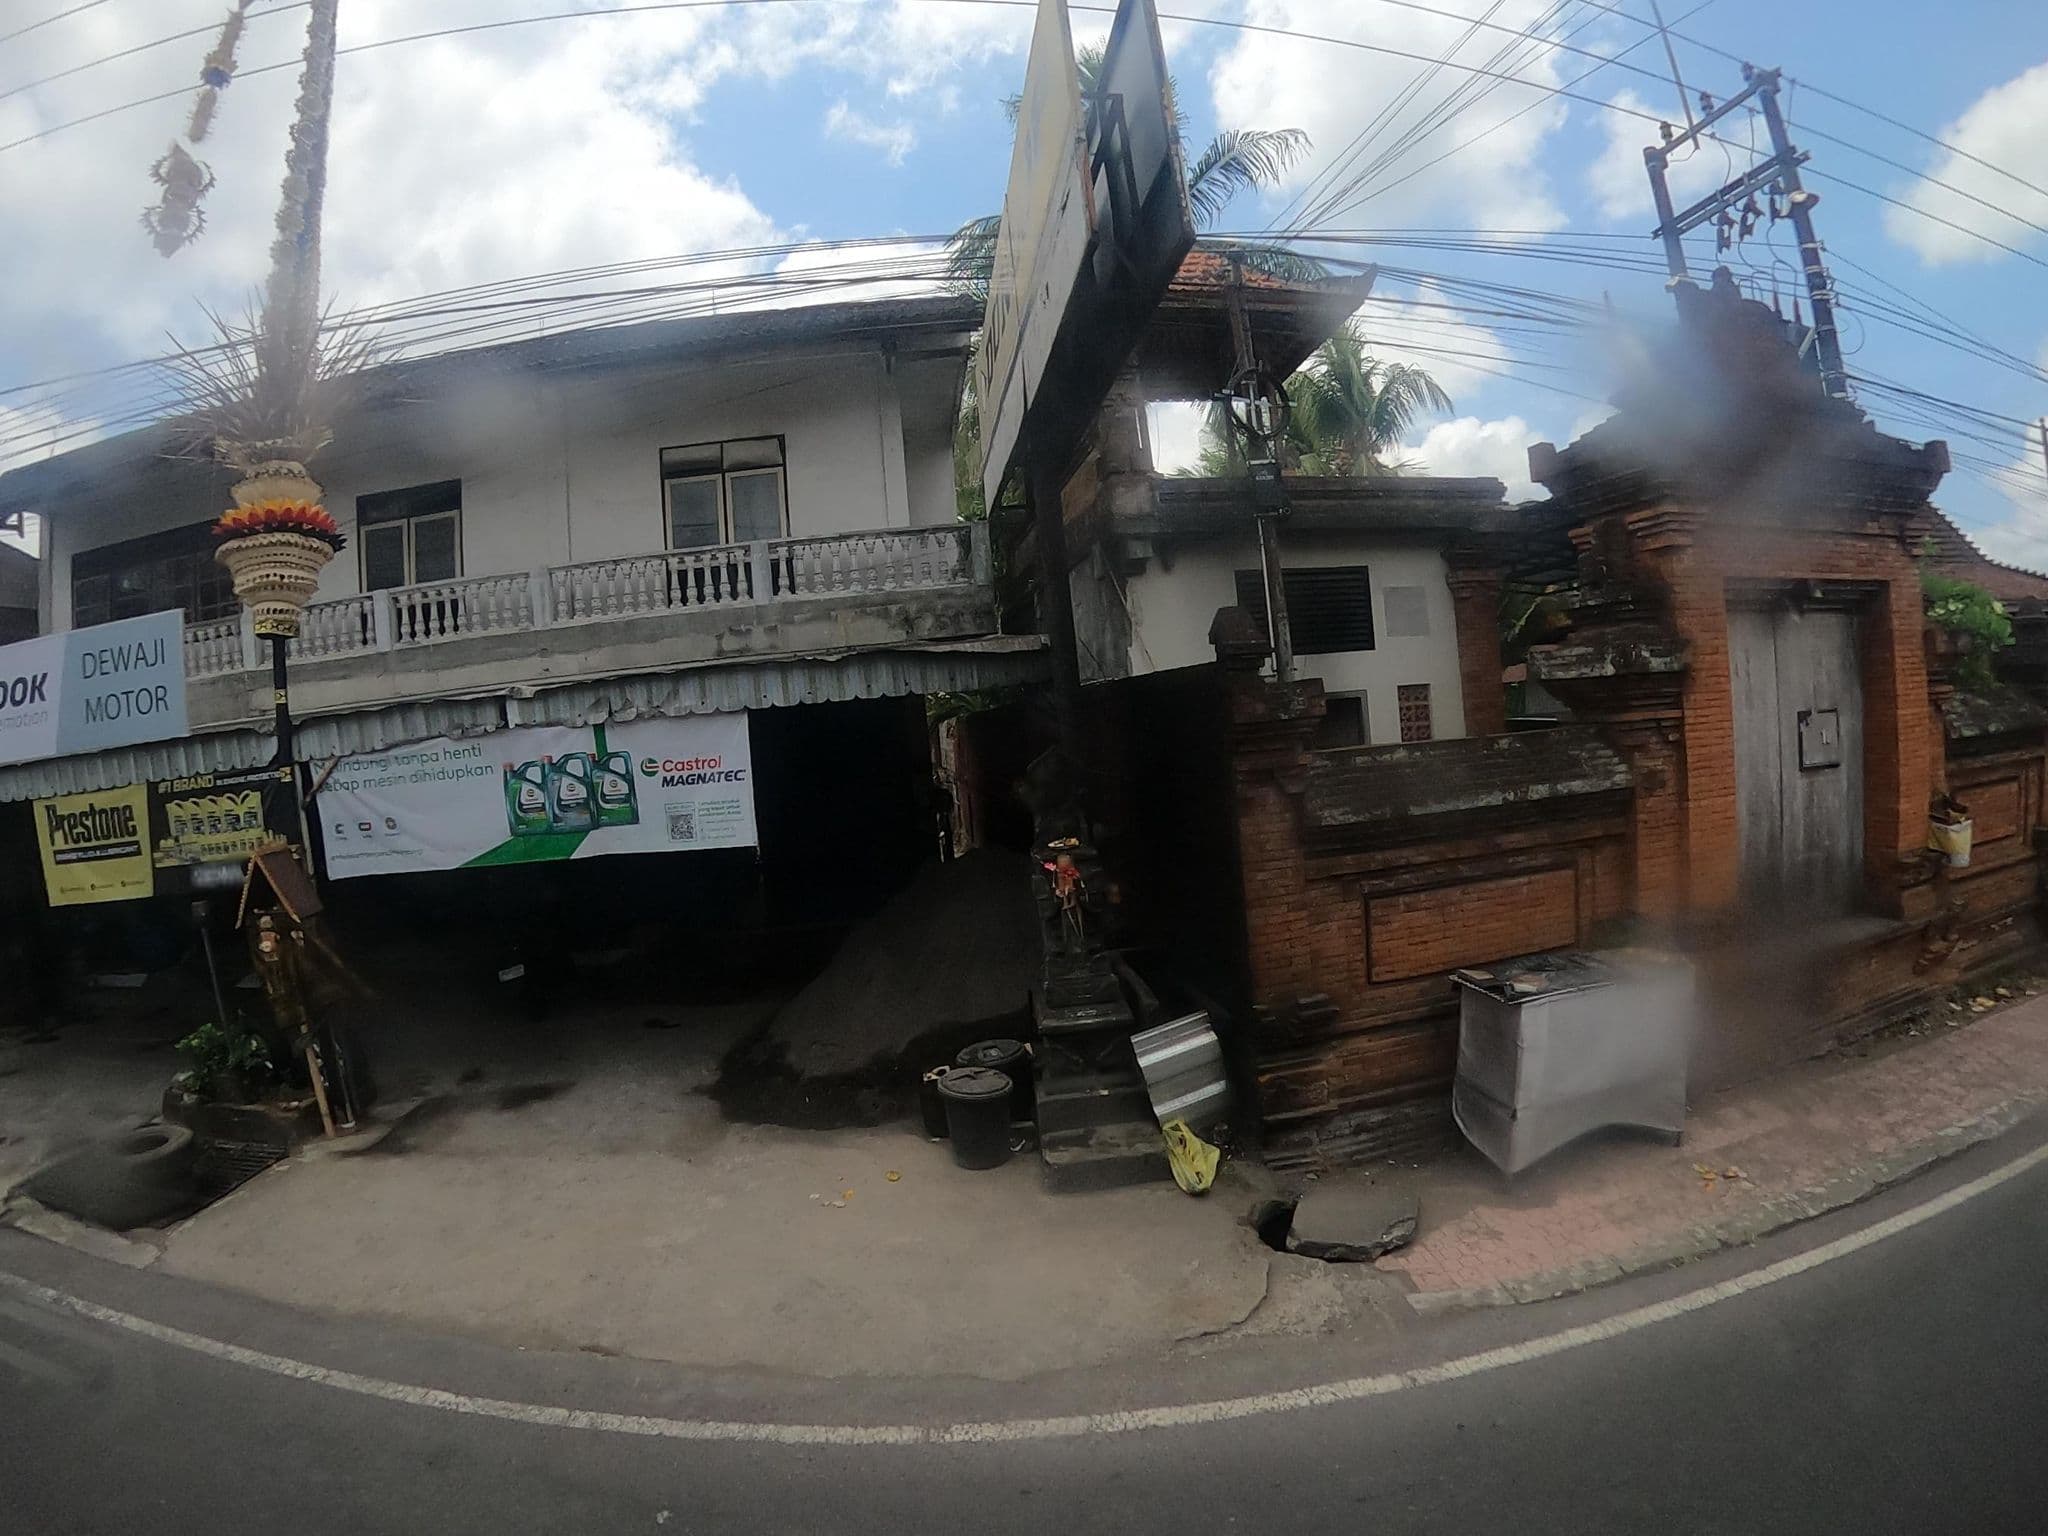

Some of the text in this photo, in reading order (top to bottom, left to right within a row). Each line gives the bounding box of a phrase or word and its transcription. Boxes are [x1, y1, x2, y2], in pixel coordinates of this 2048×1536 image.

[82, 638, 165, 679] DEWAJI
[84, 685, 169, 724] MOTOR
[394, 750, 439, 766] tanpa
[443, 743, 482, 761] henti
[662, 755, 722, 773] Castrol
[173, 775, 214, 792] BRAND
[409, 764, 494, 785] dihidupkan
[661, 769, 746, 788] MAGNATEC
[45, 803, 138, 847] Prestone
